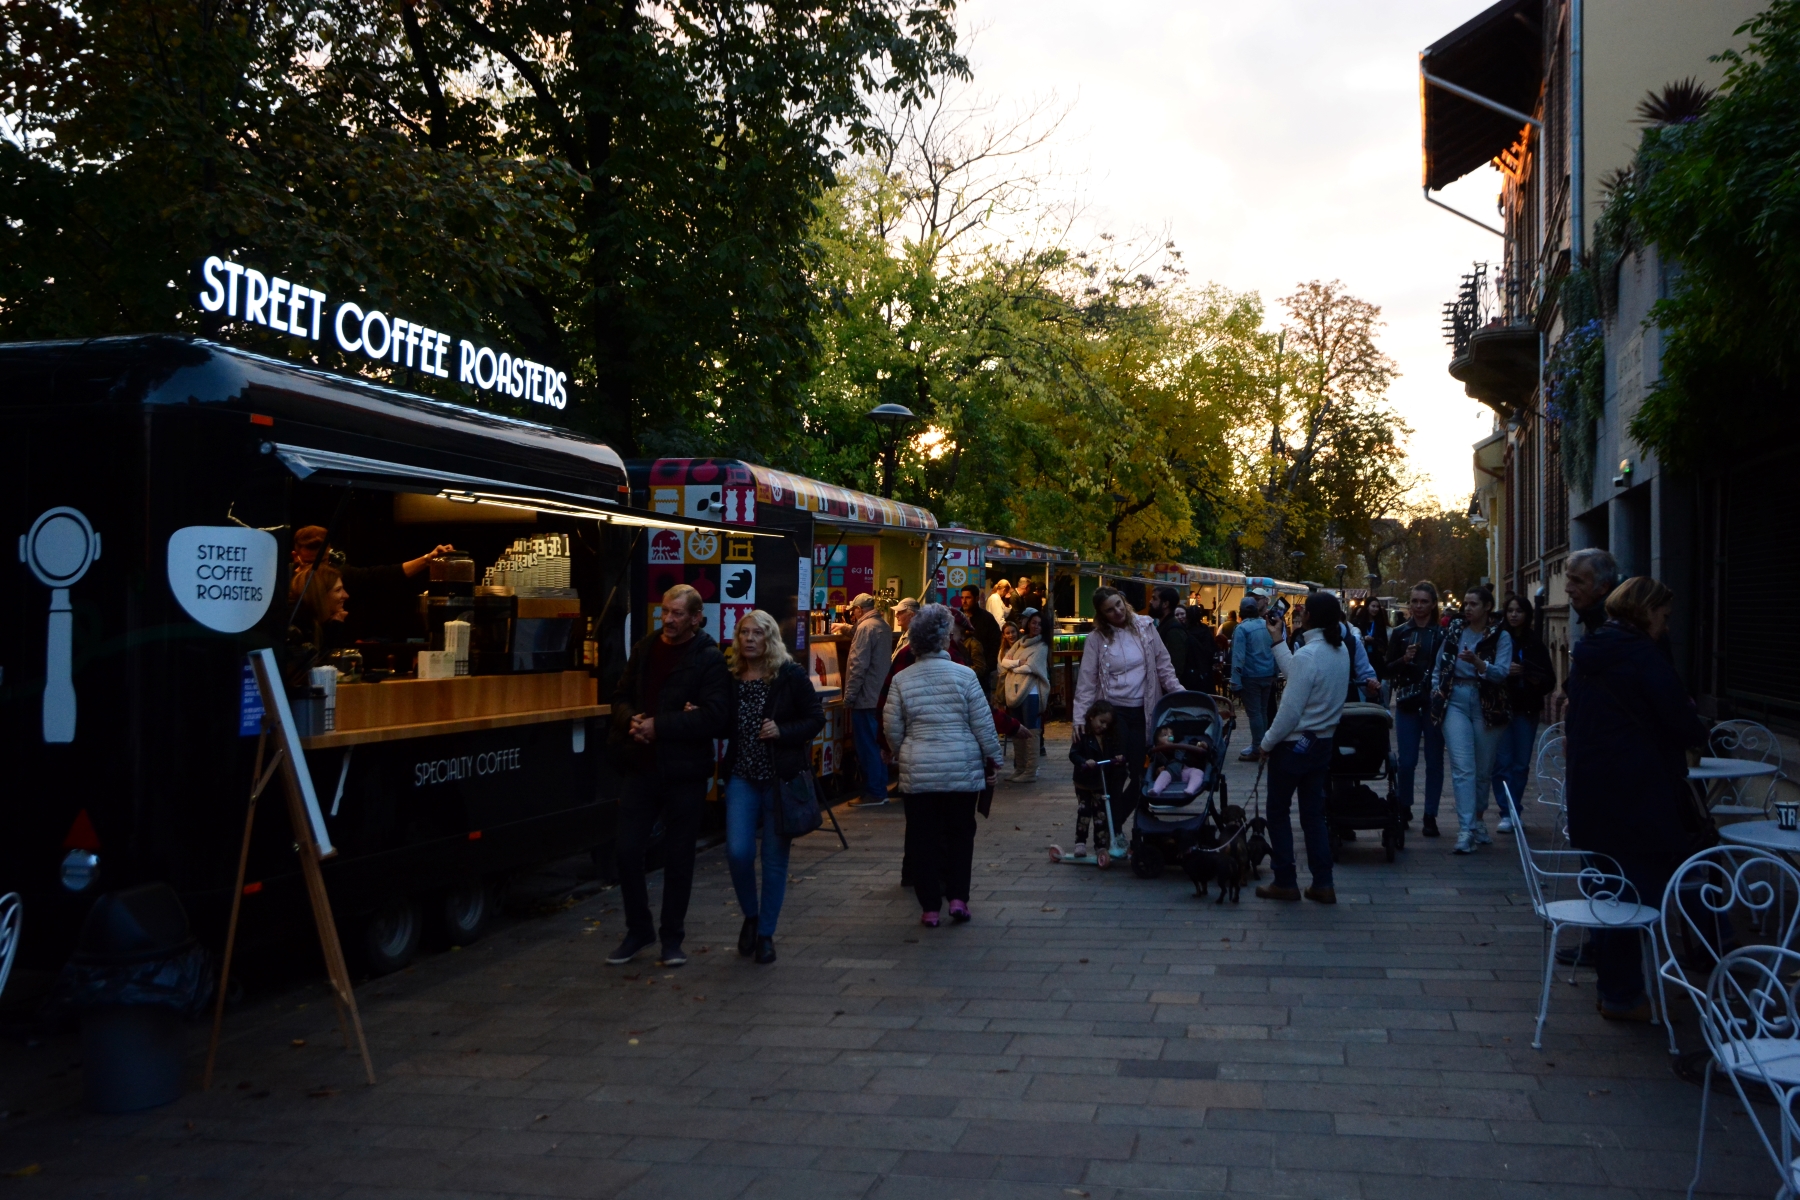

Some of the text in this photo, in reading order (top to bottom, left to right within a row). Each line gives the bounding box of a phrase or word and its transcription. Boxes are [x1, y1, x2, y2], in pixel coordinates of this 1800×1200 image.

[200, 255, 567, 410] STREET COFFEE ROASTERS
[197, 544, 247, 562] STREET
[196, 564, 253, 582] COFFEE
[196, 584, 263, 602] ROASTERS
[414, 747, 521, 787] SPECIALTY COFFEE
